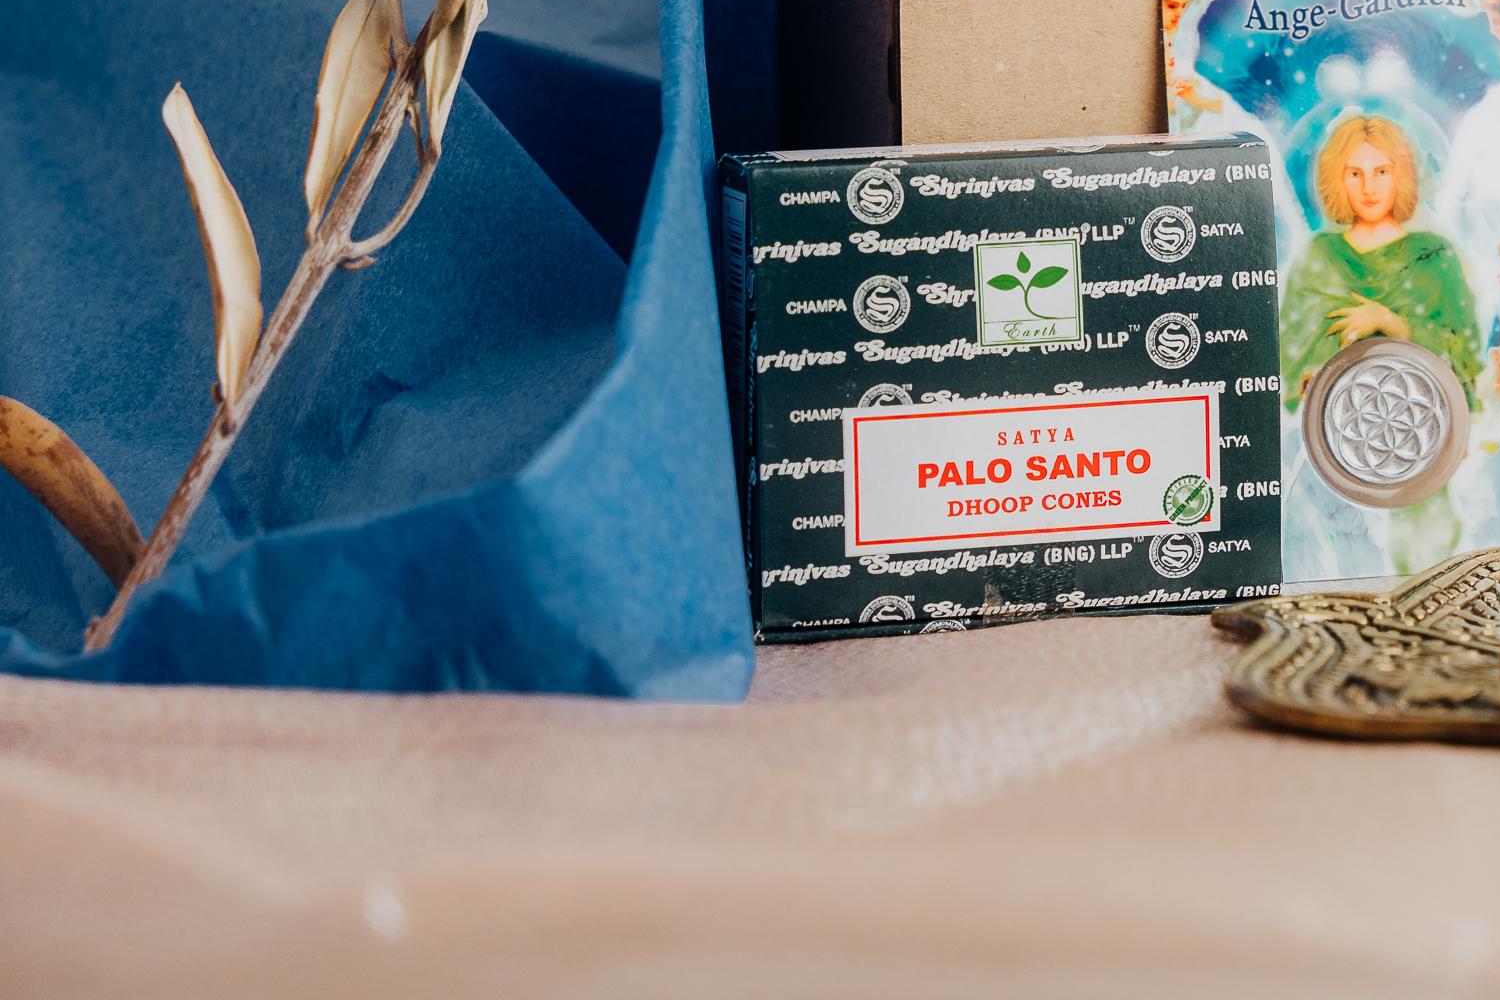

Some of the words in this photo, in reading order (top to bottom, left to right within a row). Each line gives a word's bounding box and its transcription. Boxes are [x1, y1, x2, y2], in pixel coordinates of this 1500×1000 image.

[909, 174, 1036, 199] Shrinivas
[1042, 165, 1217, 191] Sugandhalaya
[779, 190, 841, 206] CHAMPA
[1091, 224, 1125, 242] LLP
[1200, 222, 1245, 238] SATYA
[1080, 272, 1223, 299] ugandhalaya
[785, 298, 848, 315] CHAMPA
[1003, 322, 1058, 340] Earth
[1096, 331, 1131, 349] LLP
[1204, 329, 1249, 344] SATYA
[997, 427, 1075, 446] SATYA
[1219, 434, 1251, 449] ATYA
[917, 458, 1013, 489] PALO
[1025, 448, 1151, 482] SANTO
[1236, 480, 1281, 501] (BNG
[947, 495, 1034, 518] DHOOP
[1041, 490, 1123, 511] CONES
[1207, 539, 1252, 554] SATYA
[858, 549, 1035, 577] Sugandhalaya
[1043, 544, 1096, 566] (BNG)
[1100, 542, 1133, 560] LLP
